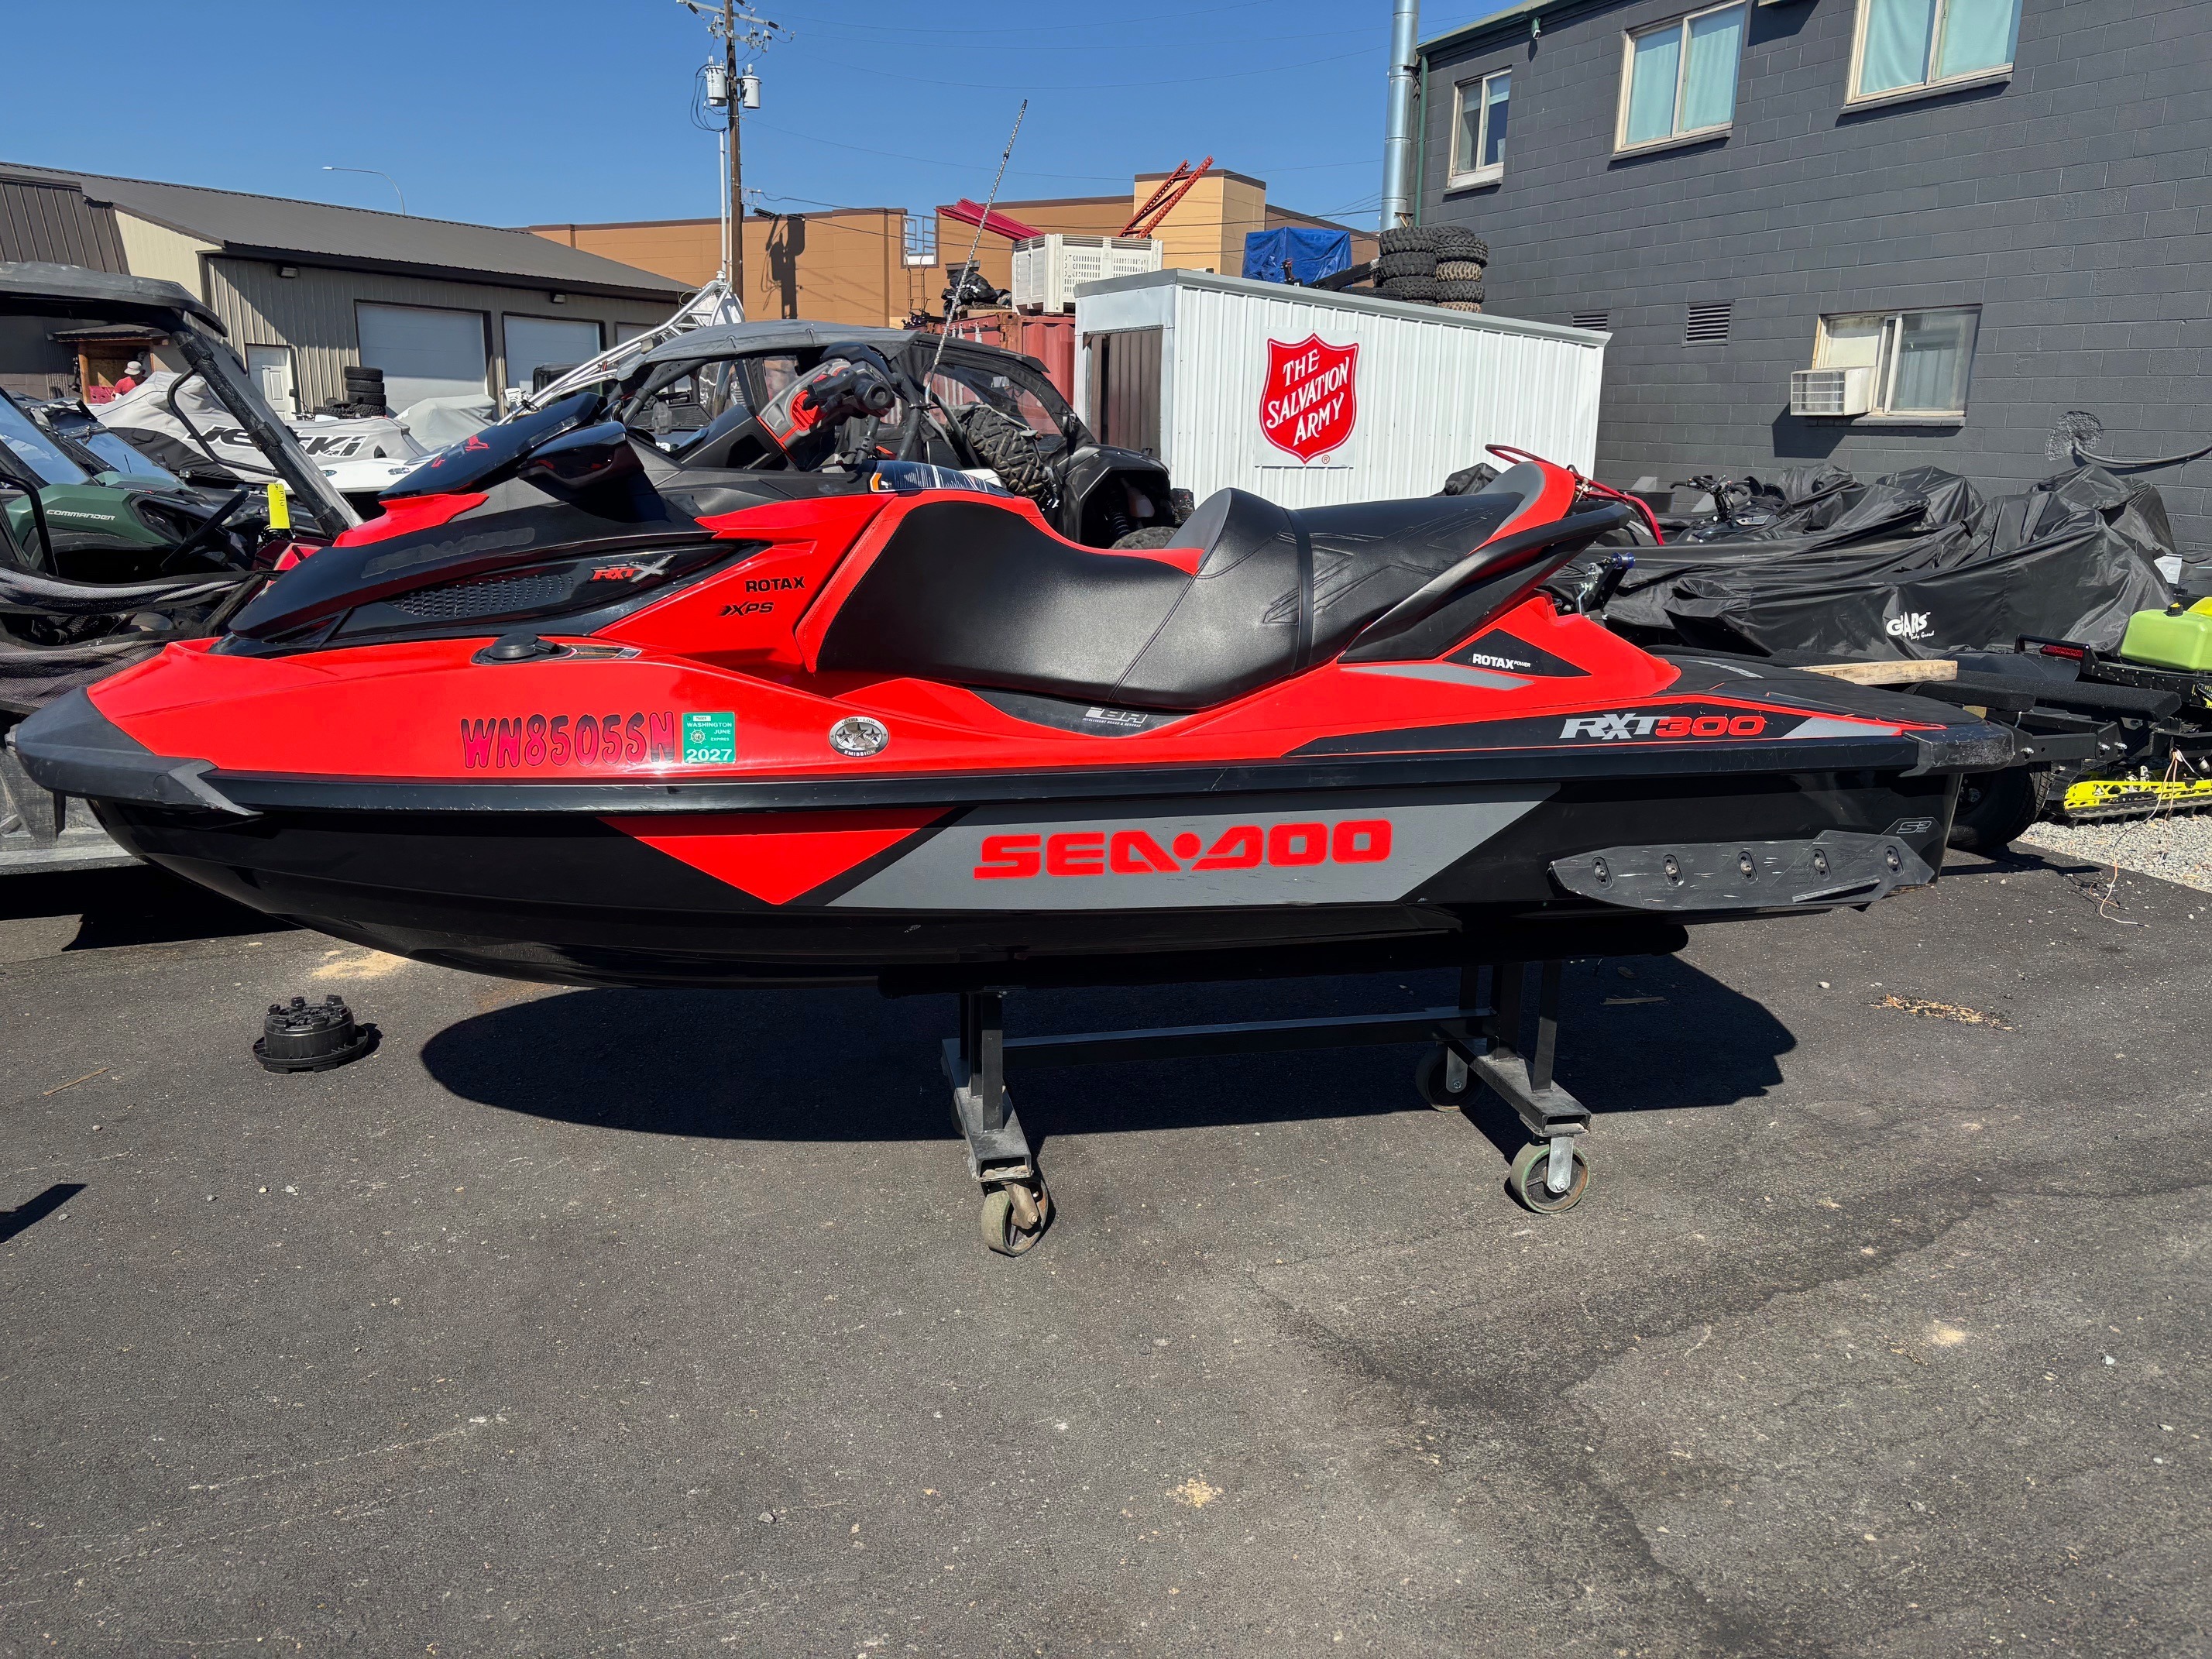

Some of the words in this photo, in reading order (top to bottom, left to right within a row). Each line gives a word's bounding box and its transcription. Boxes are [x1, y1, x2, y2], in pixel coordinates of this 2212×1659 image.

[1283, 349, 1320, 386] THE
[1266, 356, 1349, 429] SALVATION
[1293, 392, 1345, 447] ARMY
[46, 510, 115, 520] COMMANDER
[745, 576, 805, 592] ROTAX
[1473, 653, 1514, 669] ROTAX
[460, 711, 676, 769] WN8505SN
[685, 748, 733, 761] 2027
